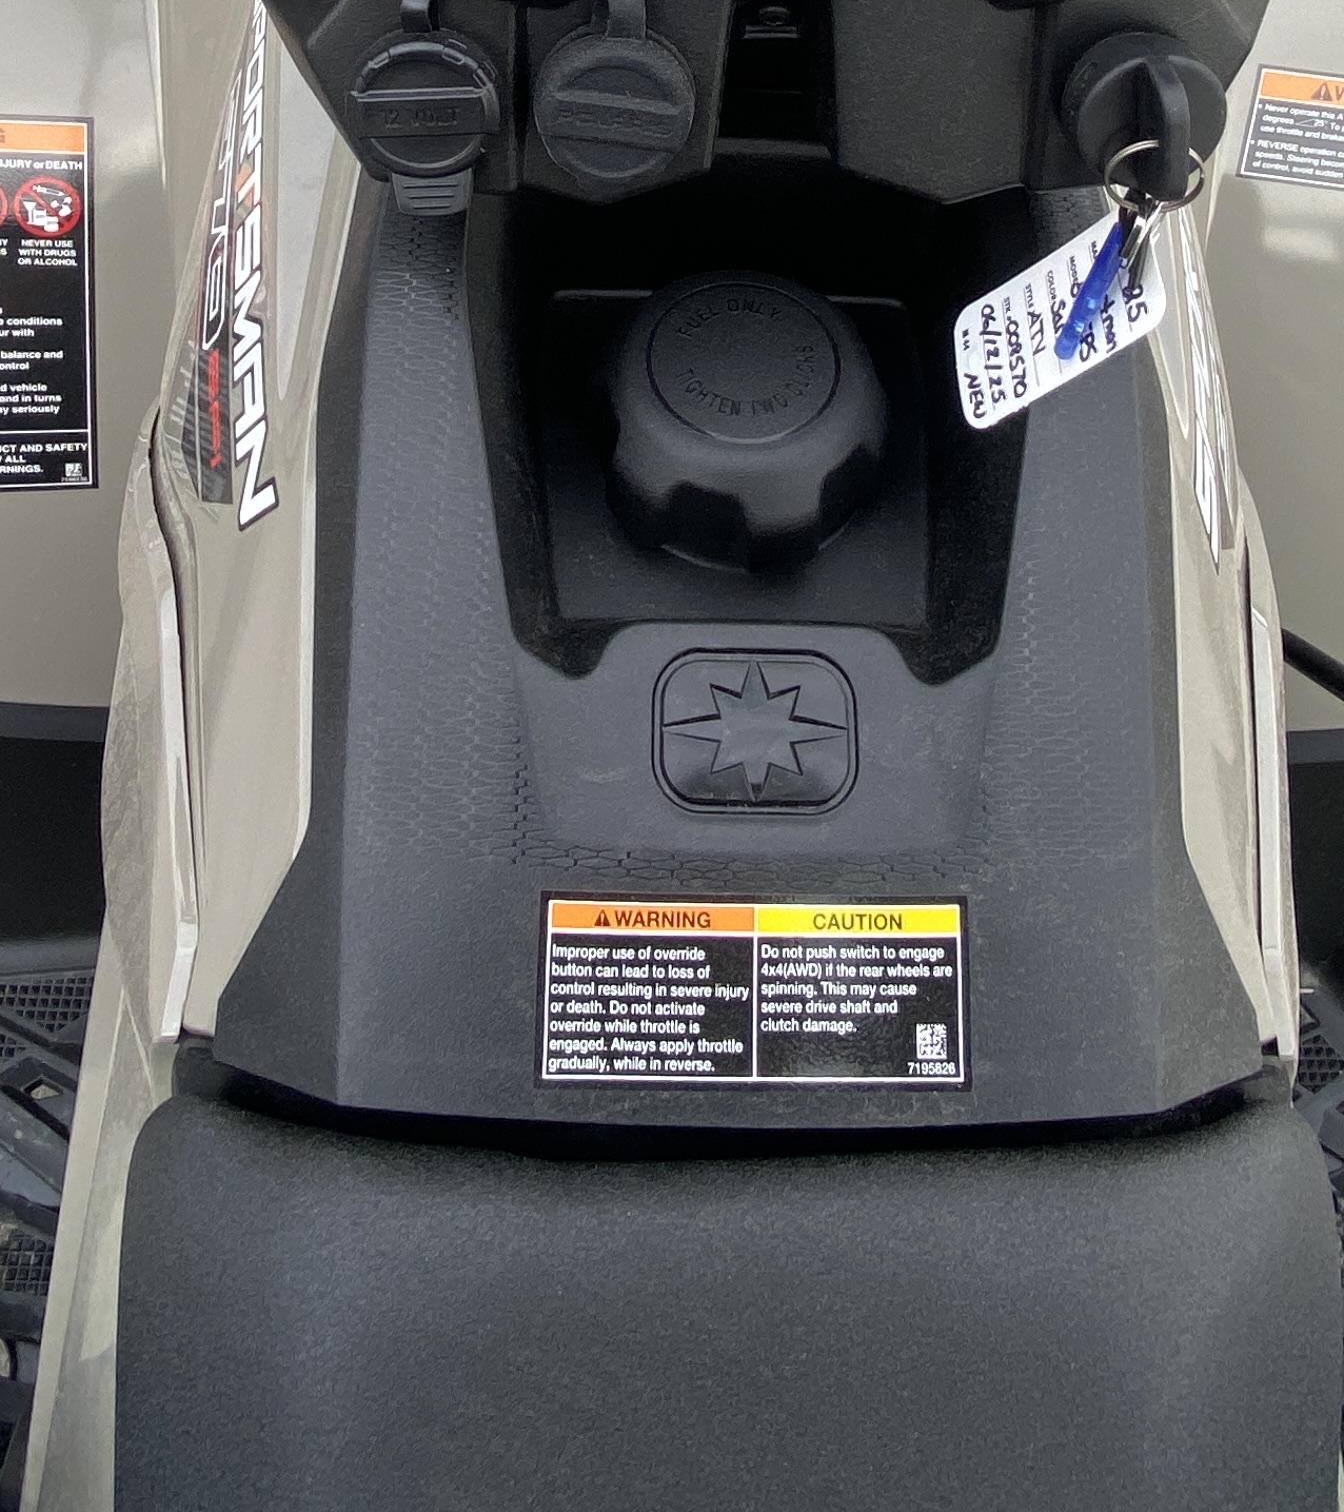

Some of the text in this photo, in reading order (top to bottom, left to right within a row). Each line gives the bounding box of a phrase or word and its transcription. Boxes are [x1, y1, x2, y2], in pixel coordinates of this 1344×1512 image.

[45, 160, 83, 170] DEATH
[1025, 283, 1034, 312] STYLE
[675, 306, 721, 339] FUEL
[1027, 310, 1046, 356] ATV
[964, 372, 986, 418] NEW
[19, 444, 42, 453] AND
[45, 443, 88, 452] SAFETY
[5, 455, 25, 463] ALL
[614, 910, 711, 928] WARNING
[813, 913, 903, 930] CAUTION
[552, 943, 705, 961] Improper use of override
[761, 944, 944, 962] Do not push switch to engage
[552, 962, 710, 979] button can lead to loss of
[761, 962, 952, 979] 4x4(AWD) if the rear wheels are
[551, 982, 749, 1001] control resulting in severe injury
[761, 981, 917, 998] spinning. This may cause
[550, 1000, 705, 1015] or death. Do not activate
[761, 1000, 898, 1013] severe drive shaft and
[550, 1019, 700, 1034] override while throttle is
[761, 1018, 857, 1034] clutch damage.
[549, 1037, 743, 1055] engaged. Always apply throttle
[548, 1056, 715, 1072] gradually, while in reverse.
